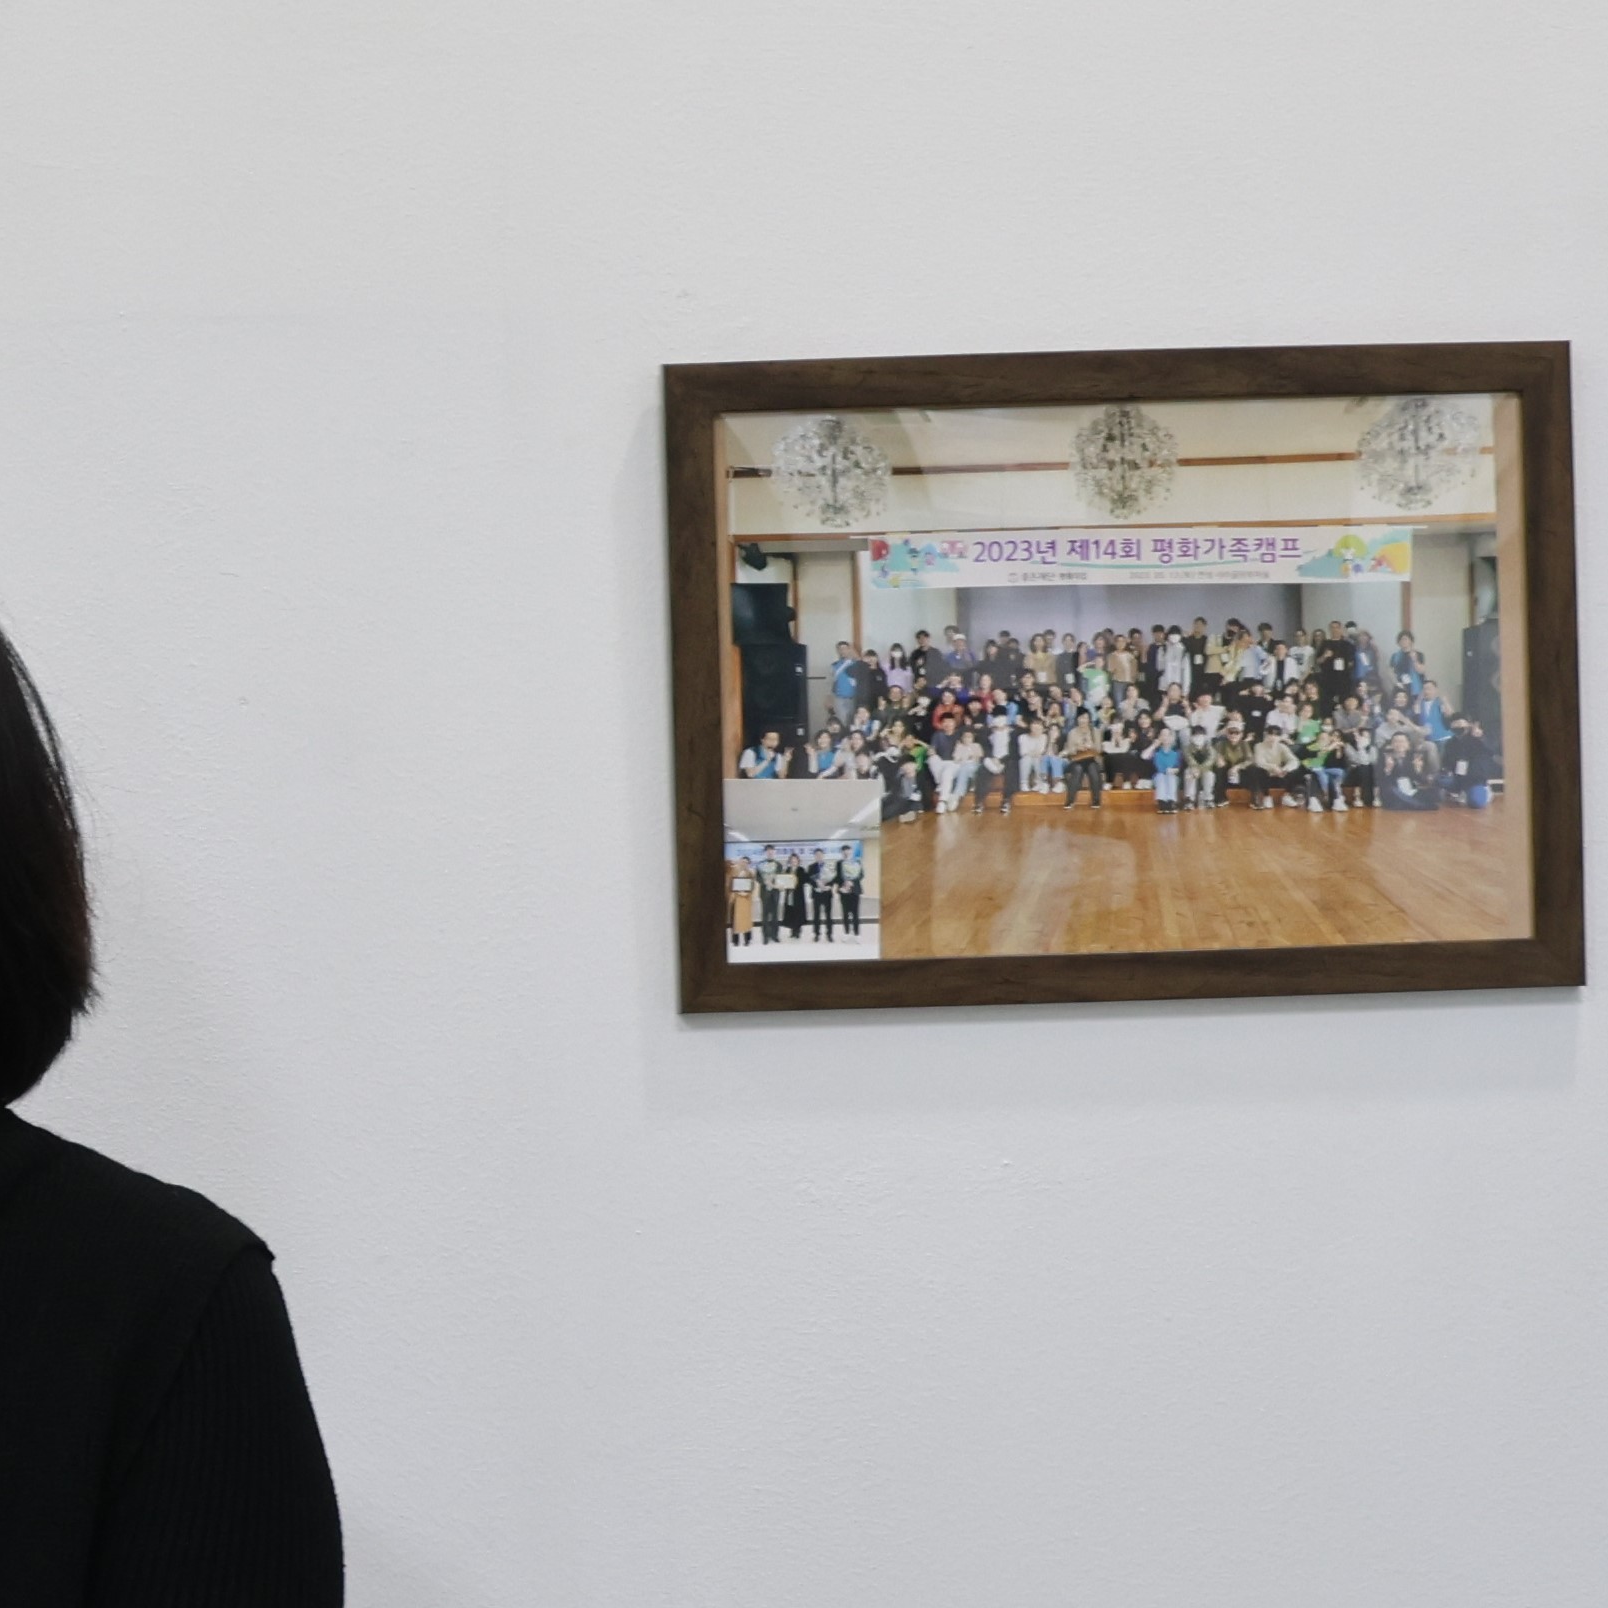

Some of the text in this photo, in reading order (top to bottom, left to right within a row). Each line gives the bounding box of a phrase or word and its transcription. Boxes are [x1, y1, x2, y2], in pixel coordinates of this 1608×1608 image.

[972, 537, 1302, 565] 2023년 제14회 평화가족캠프
